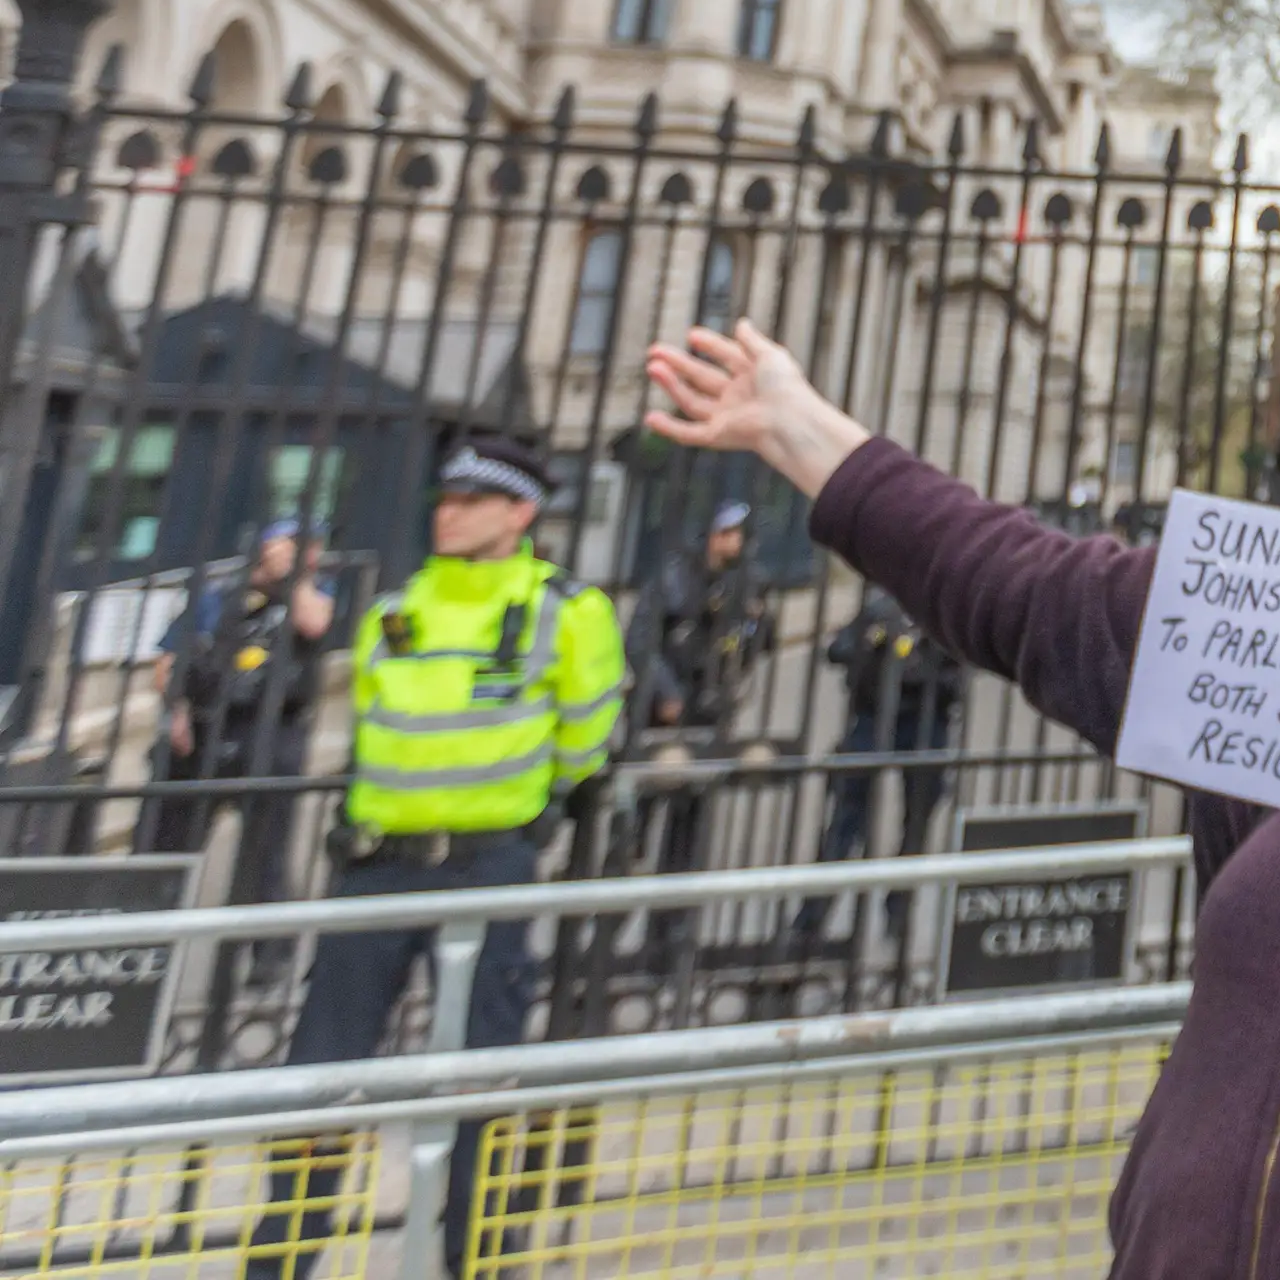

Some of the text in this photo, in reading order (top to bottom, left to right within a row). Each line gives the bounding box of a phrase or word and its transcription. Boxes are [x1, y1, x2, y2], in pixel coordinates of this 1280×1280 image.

[1187, 672, 1268, 718] BOTH
[956, 877, 1130, 923] ENTRANCE
[980, 916, 1094, 959] CLEAR
[0, 947, 170, 990] TRANCE
[0, 990, 115, 1032] LEAR
